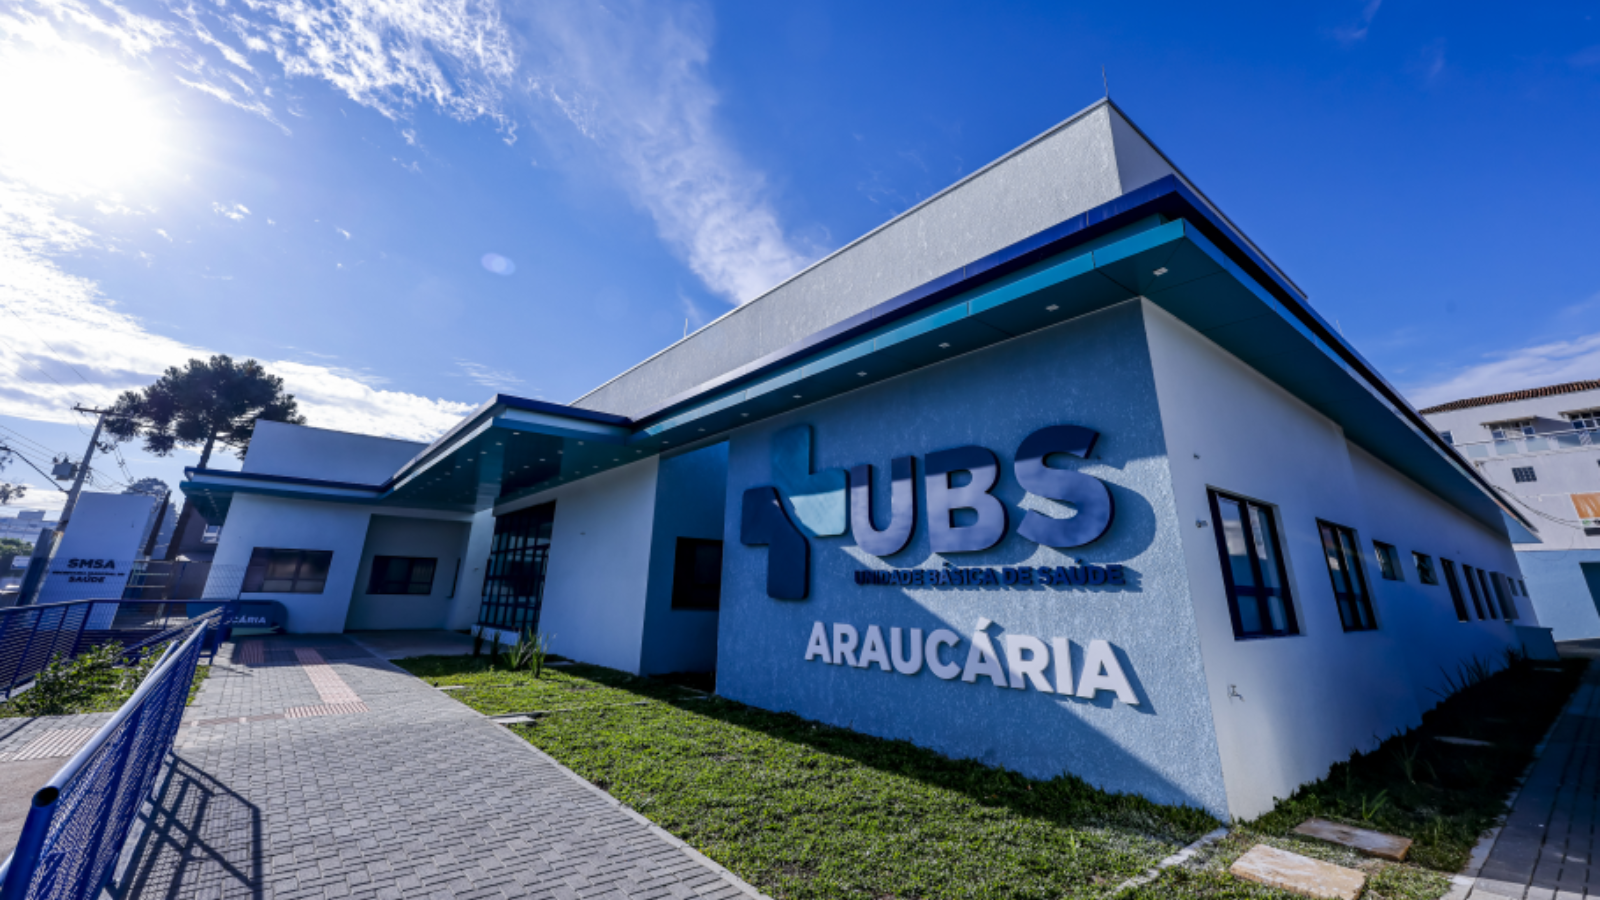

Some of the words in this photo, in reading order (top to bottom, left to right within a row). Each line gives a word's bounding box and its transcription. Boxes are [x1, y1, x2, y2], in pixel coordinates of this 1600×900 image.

[850, 425, 1114, 557] UBS
[67, 558, 115, 569] SMSA
[854, 569, 923, 586] UNIDADE
[928, 562, 999, 586] BÁSICA
[1003, 566, 1033, 585] DE
[1038, 557, 1126, 586] SAÚDE
[804, 617, 1140, 705] ARAUCÁRIA
